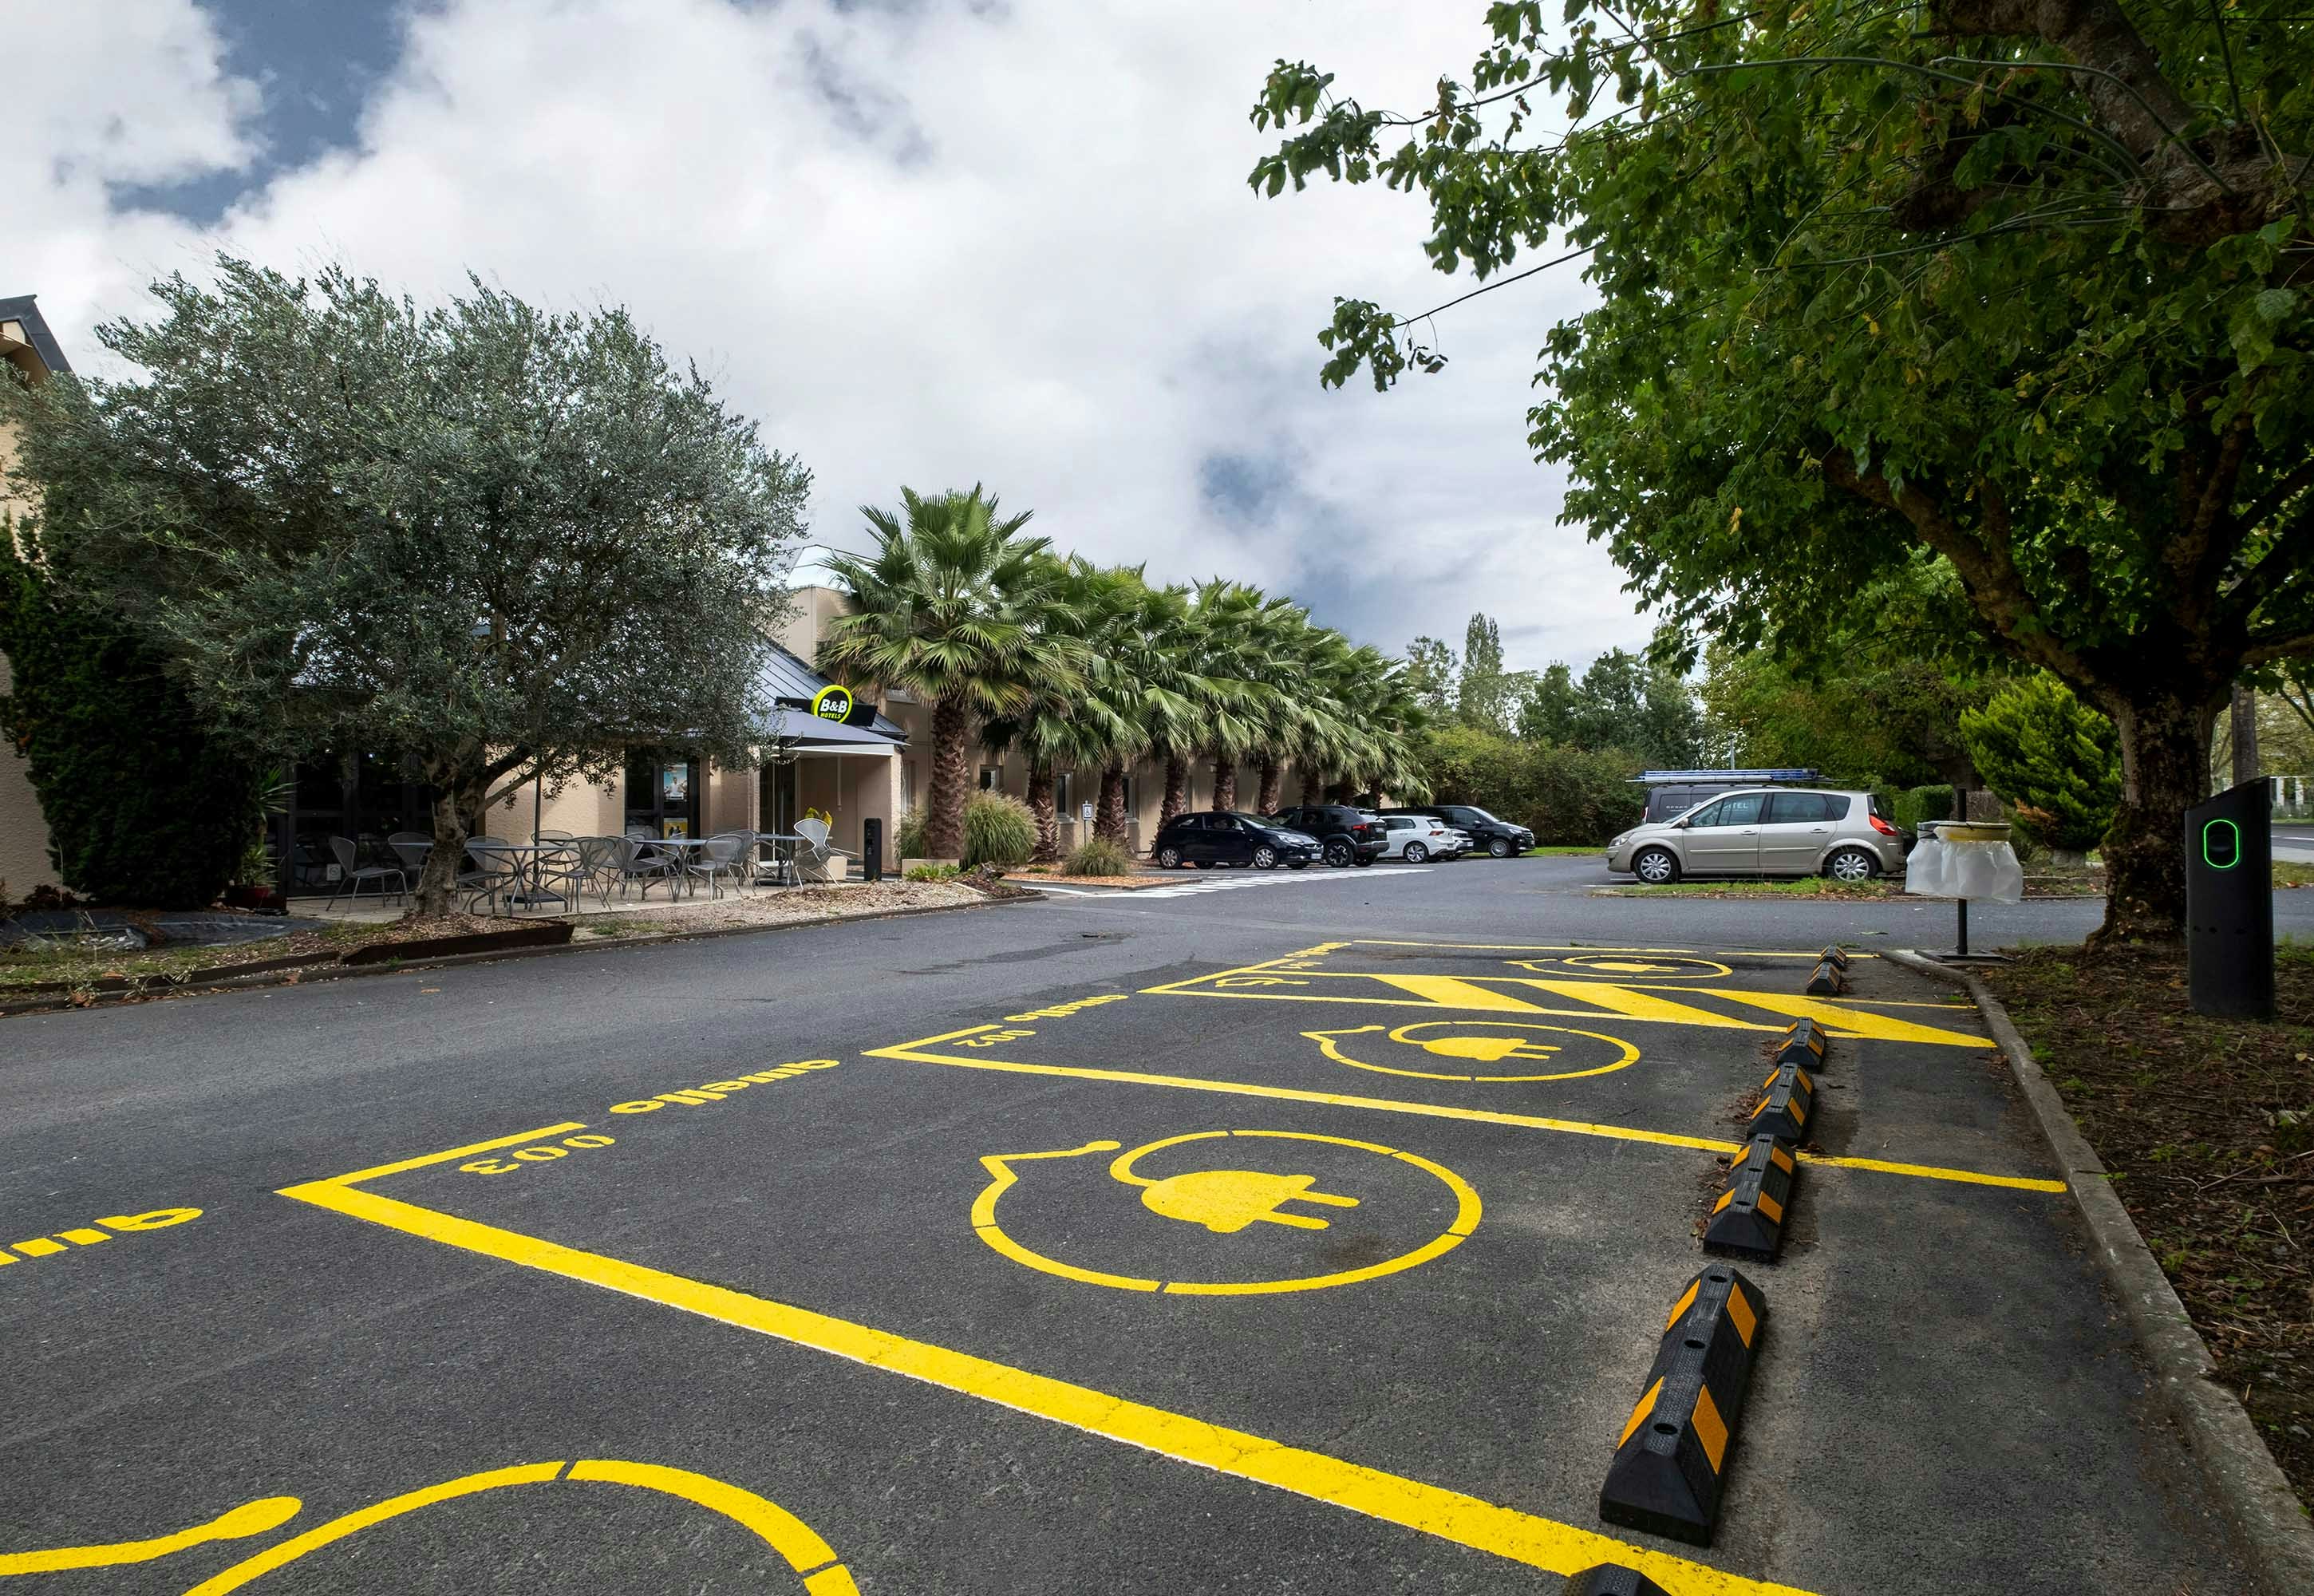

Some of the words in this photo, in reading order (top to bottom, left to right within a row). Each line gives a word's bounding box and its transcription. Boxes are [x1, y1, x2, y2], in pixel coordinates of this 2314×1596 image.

[819, 698, 847, 713] B&B
[952, 1029, 1037, 1048] 002
[459, 1134, 616, 1176] 003
